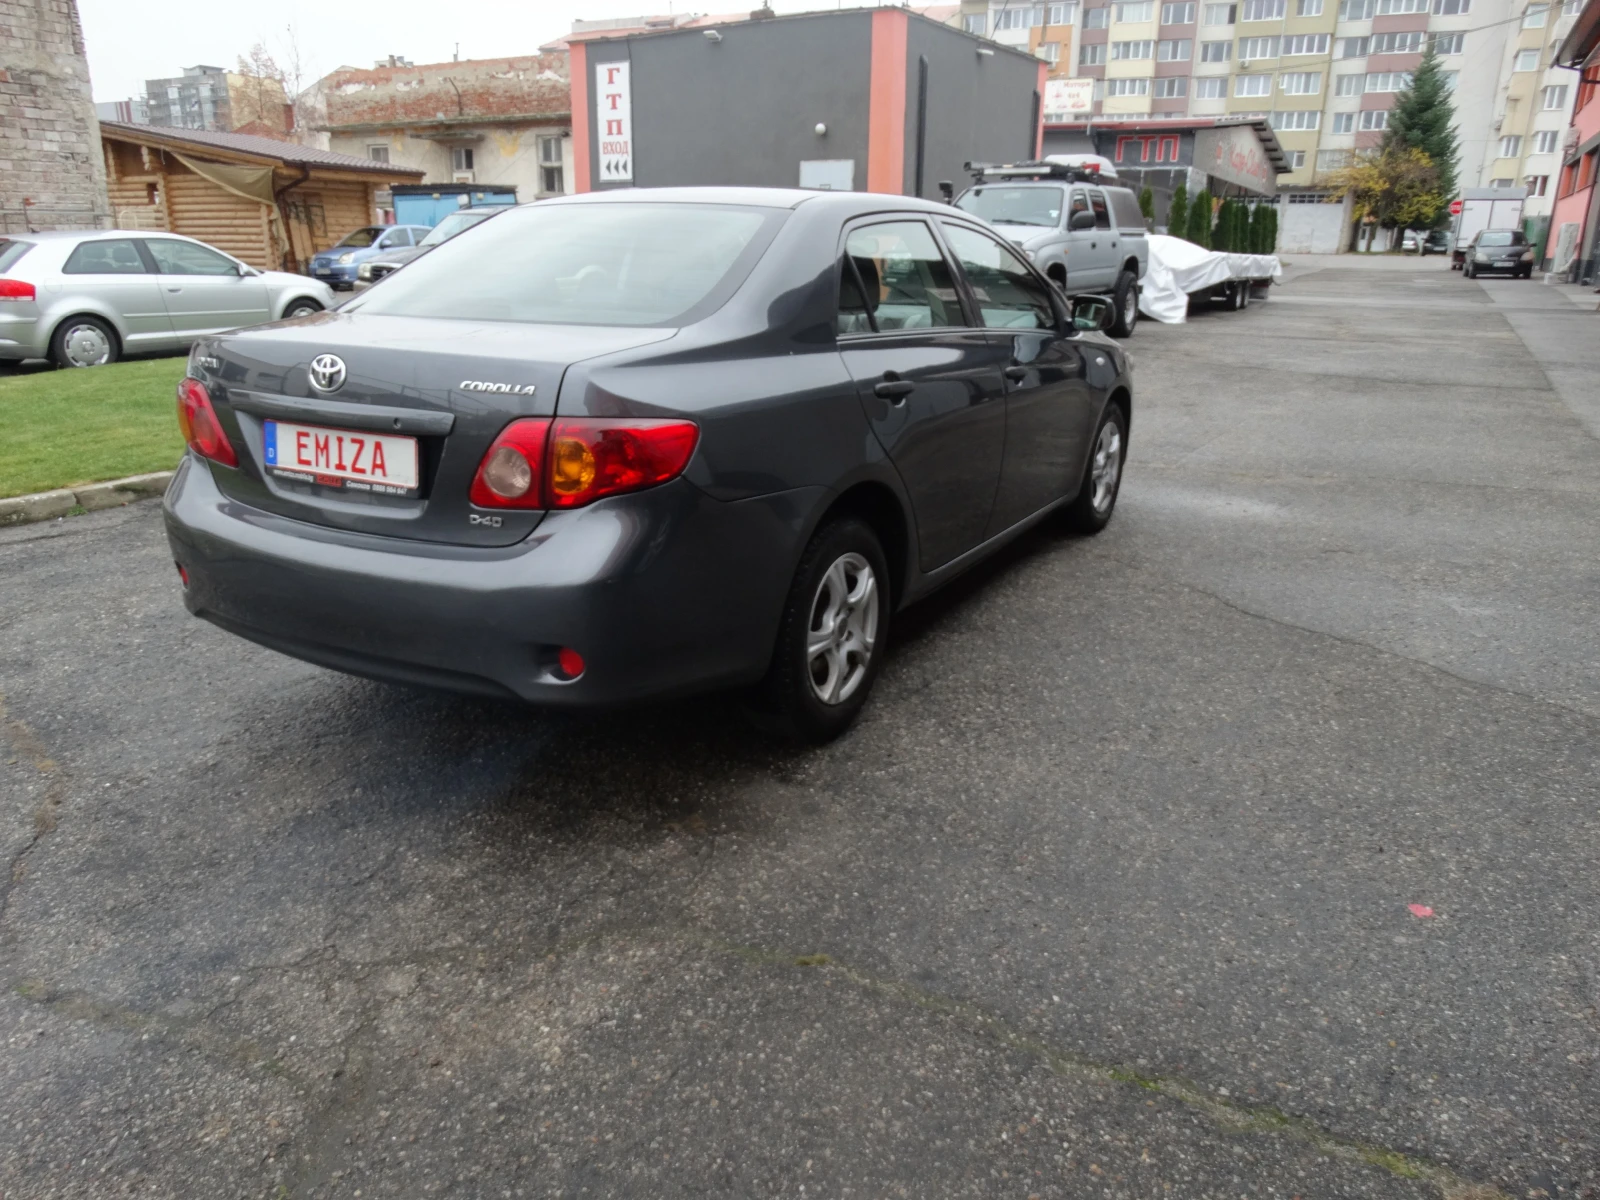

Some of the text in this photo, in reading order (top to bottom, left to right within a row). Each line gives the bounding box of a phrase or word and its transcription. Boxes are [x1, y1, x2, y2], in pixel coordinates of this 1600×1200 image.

[602, 141, 629, 156] ВХОД
[1115, 134, 1180, 163] ГТП
[459, 380, 535, 396] COROLLA
[268, 447, 274, 458] D
[296, 431, 387, 477] EMIZA
